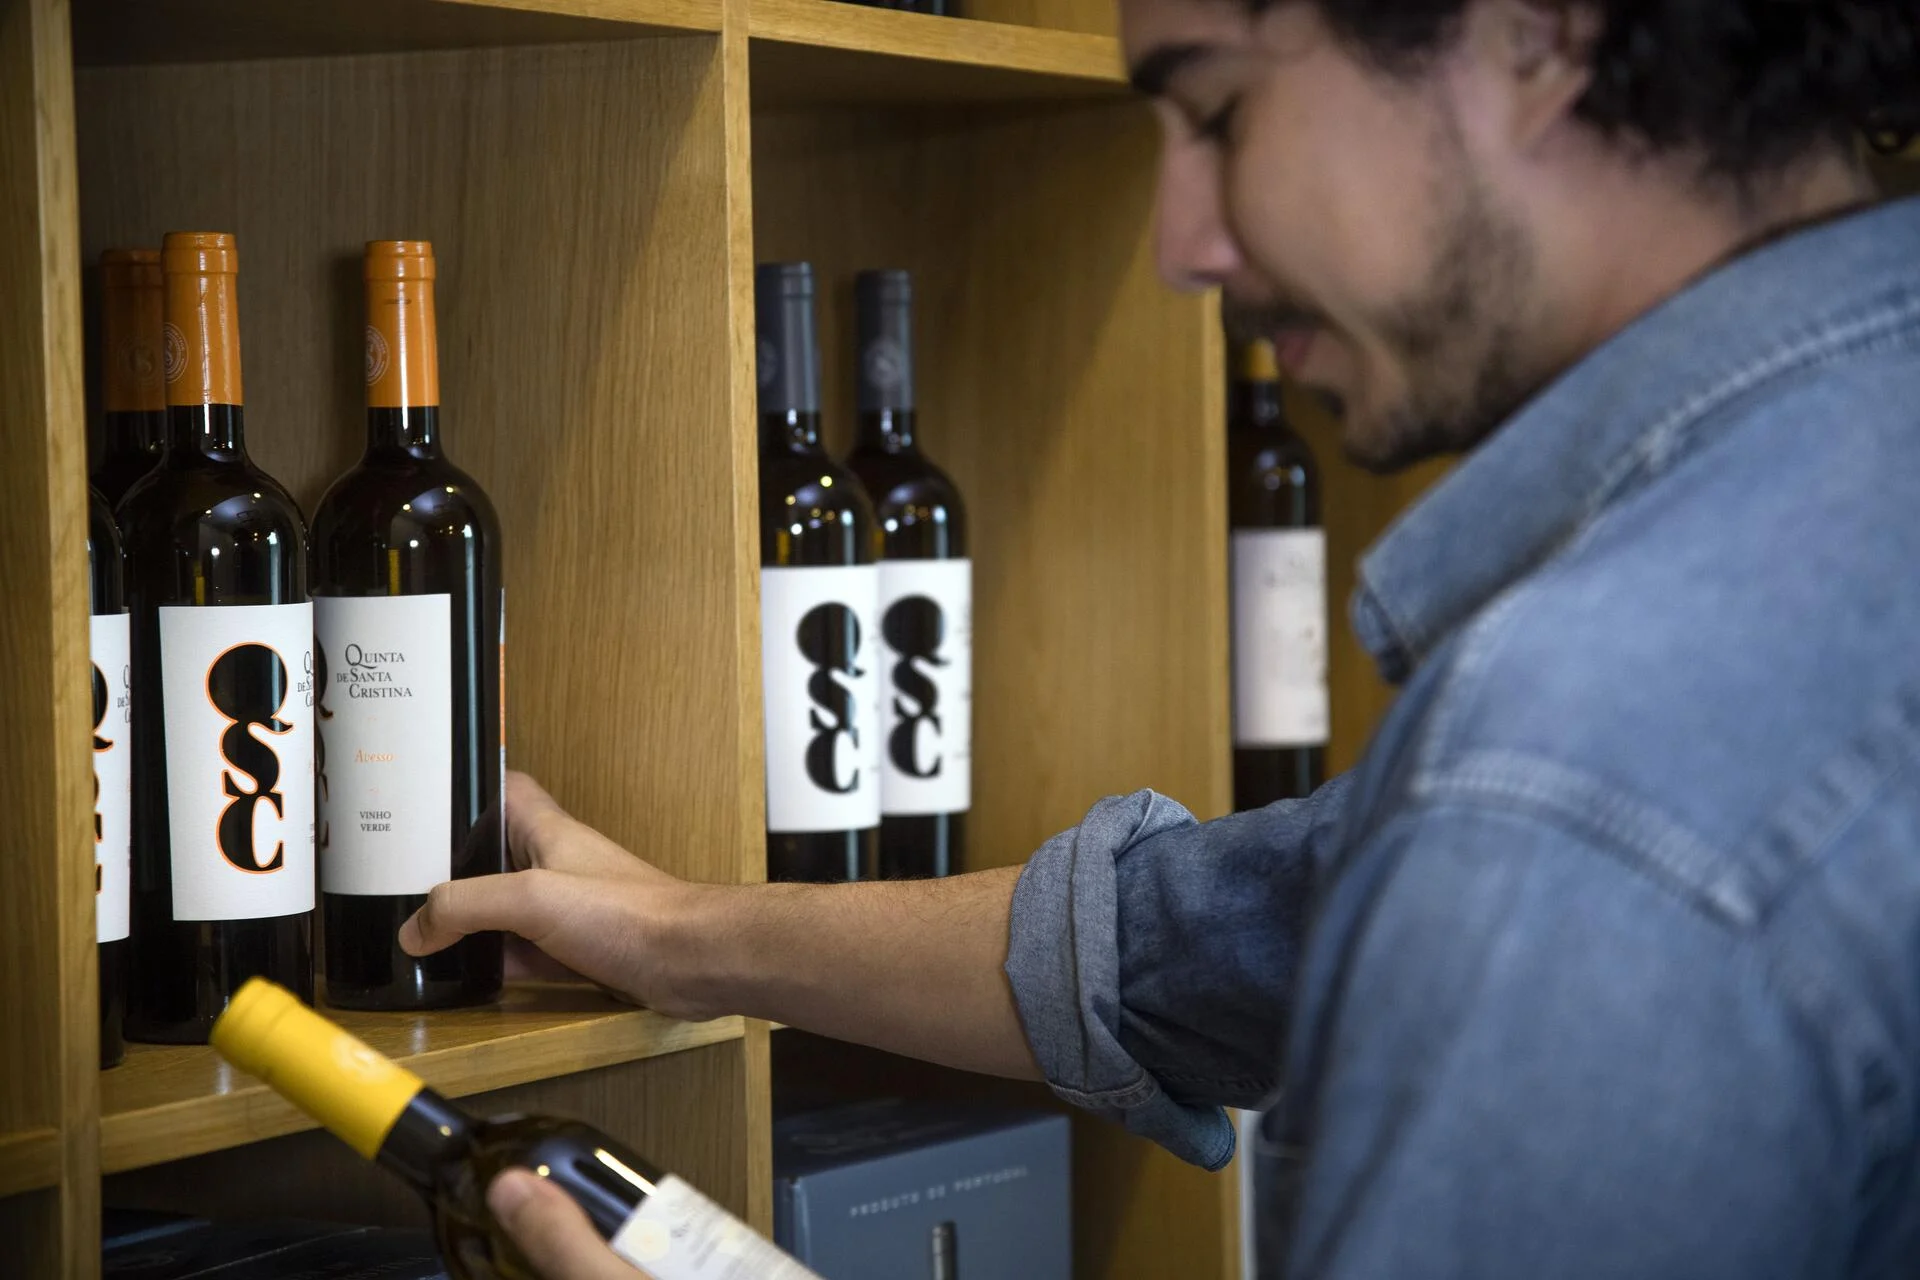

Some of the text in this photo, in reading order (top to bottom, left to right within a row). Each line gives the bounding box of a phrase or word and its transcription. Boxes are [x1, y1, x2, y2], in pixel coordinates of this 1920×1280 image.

[345, 643, 405, 669] QUINTA
[336, 667, 392, 683] DE SANTA
[349, 683, 412, 699] CRISTINA
[205, 641, 294, 874] QSC
[360, 810, 392, 820] VINHO
[360, 823, 392, 832] VERDE
